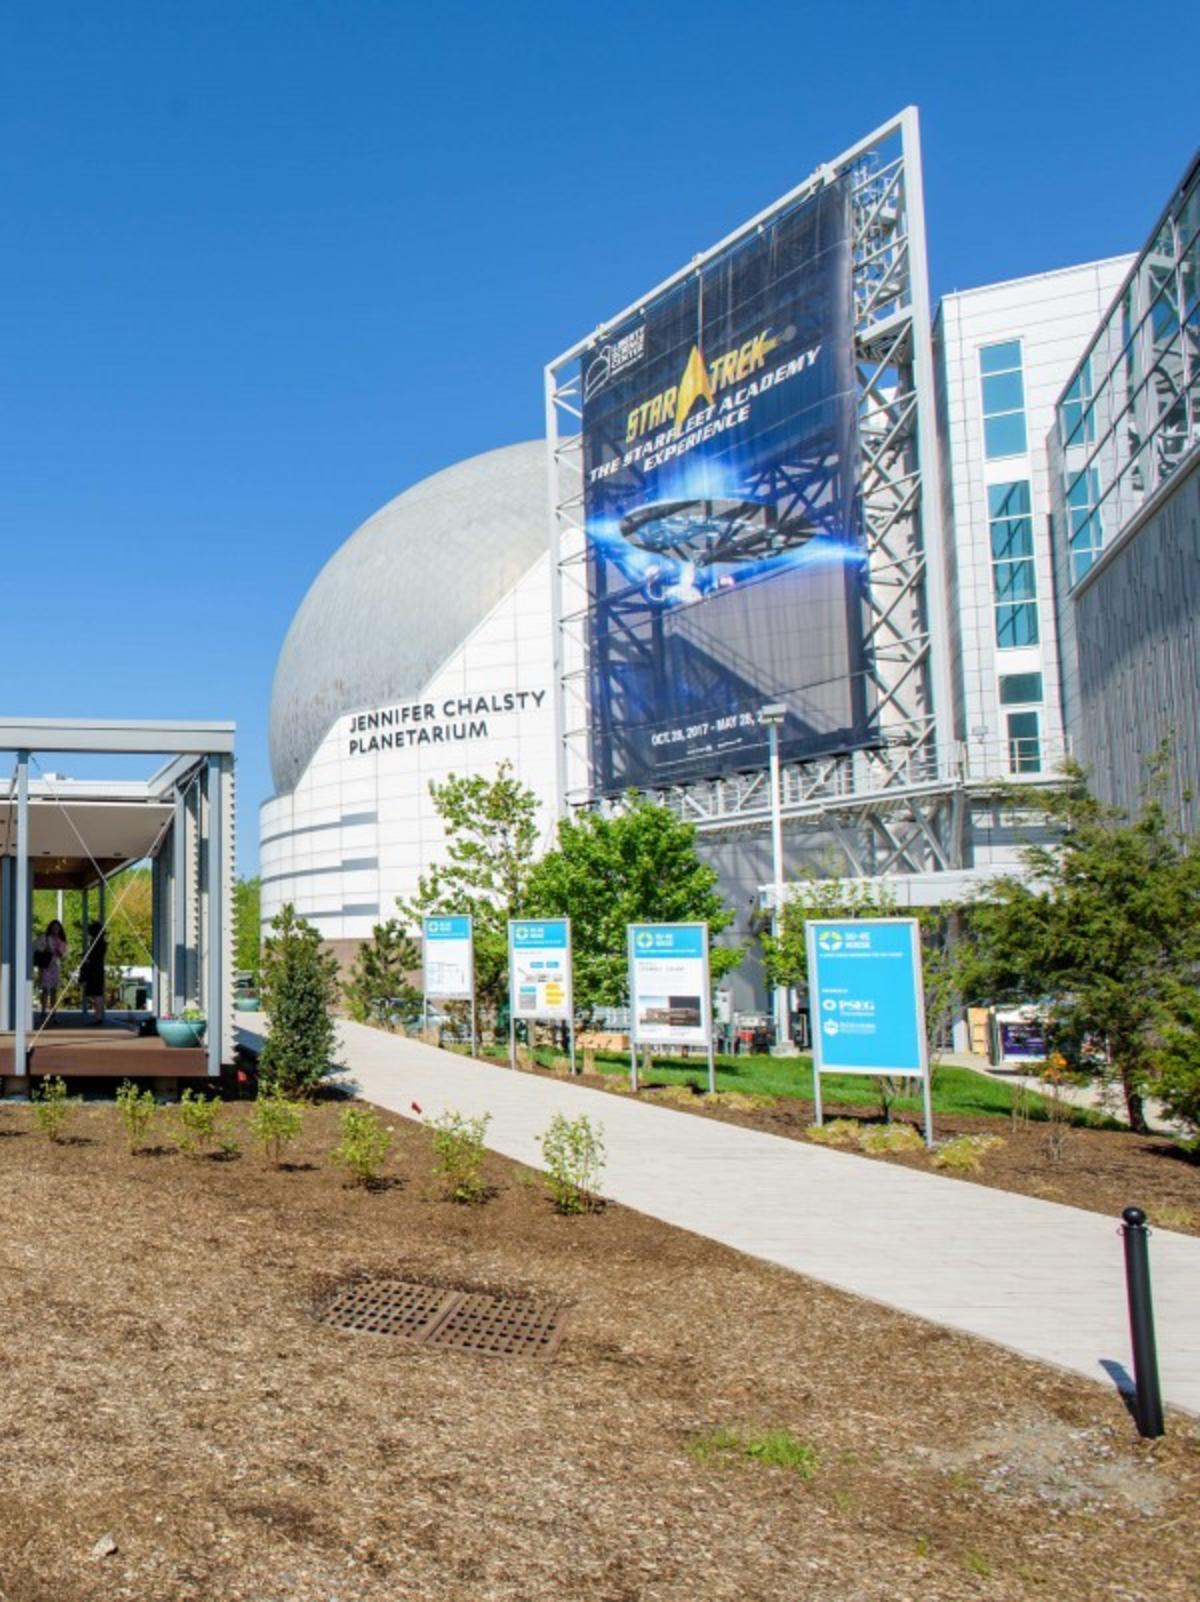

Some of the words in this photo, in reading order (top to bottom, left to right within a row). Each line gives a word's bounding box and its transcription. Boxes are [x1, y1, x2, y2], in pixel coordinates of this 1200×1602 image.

[590, 456, 621, 482] THE
[622, 403, 717, 468] STARFLEET
[718, 344, 822, 415] ACADEMY
[625, 385, 678, 444] STAR
[709, 328, 779, 395] TREK
[643, 403, 751, 473] EXPERIENCE
[349, 703, 436, 733] JENNIFER
[443, 689, 546, 718] CHALSTY
[349, 719, 488, 755] PLANETARIUM
[686, 723, 709, 739] 2017
[716, 715, 737, 732] MAY
